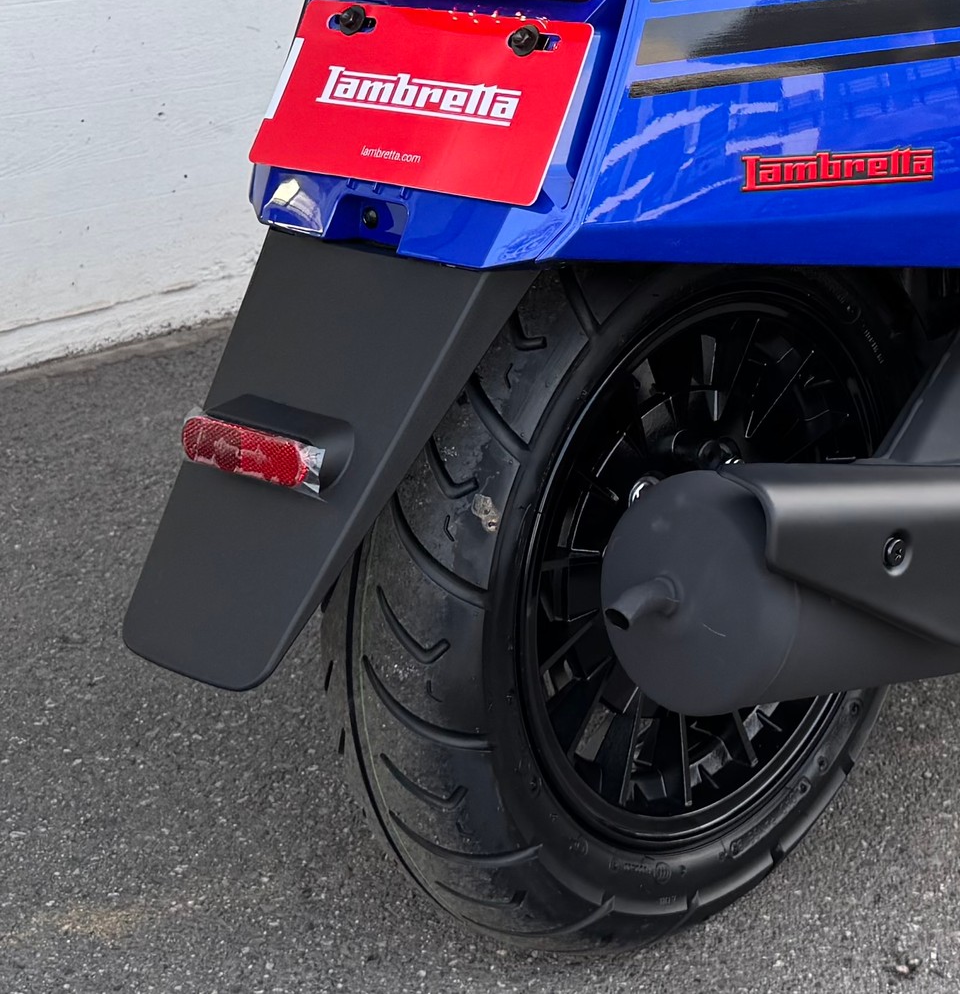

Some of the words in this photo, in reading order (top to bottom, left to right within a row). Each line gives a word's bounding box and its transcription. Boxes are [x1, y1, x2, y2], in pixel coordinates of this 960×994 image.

[315, 65, 522, 127] Lambretta
[360, 145, 422, 163] lambretta.com
[740, 145, 934, 193] Lambretta
